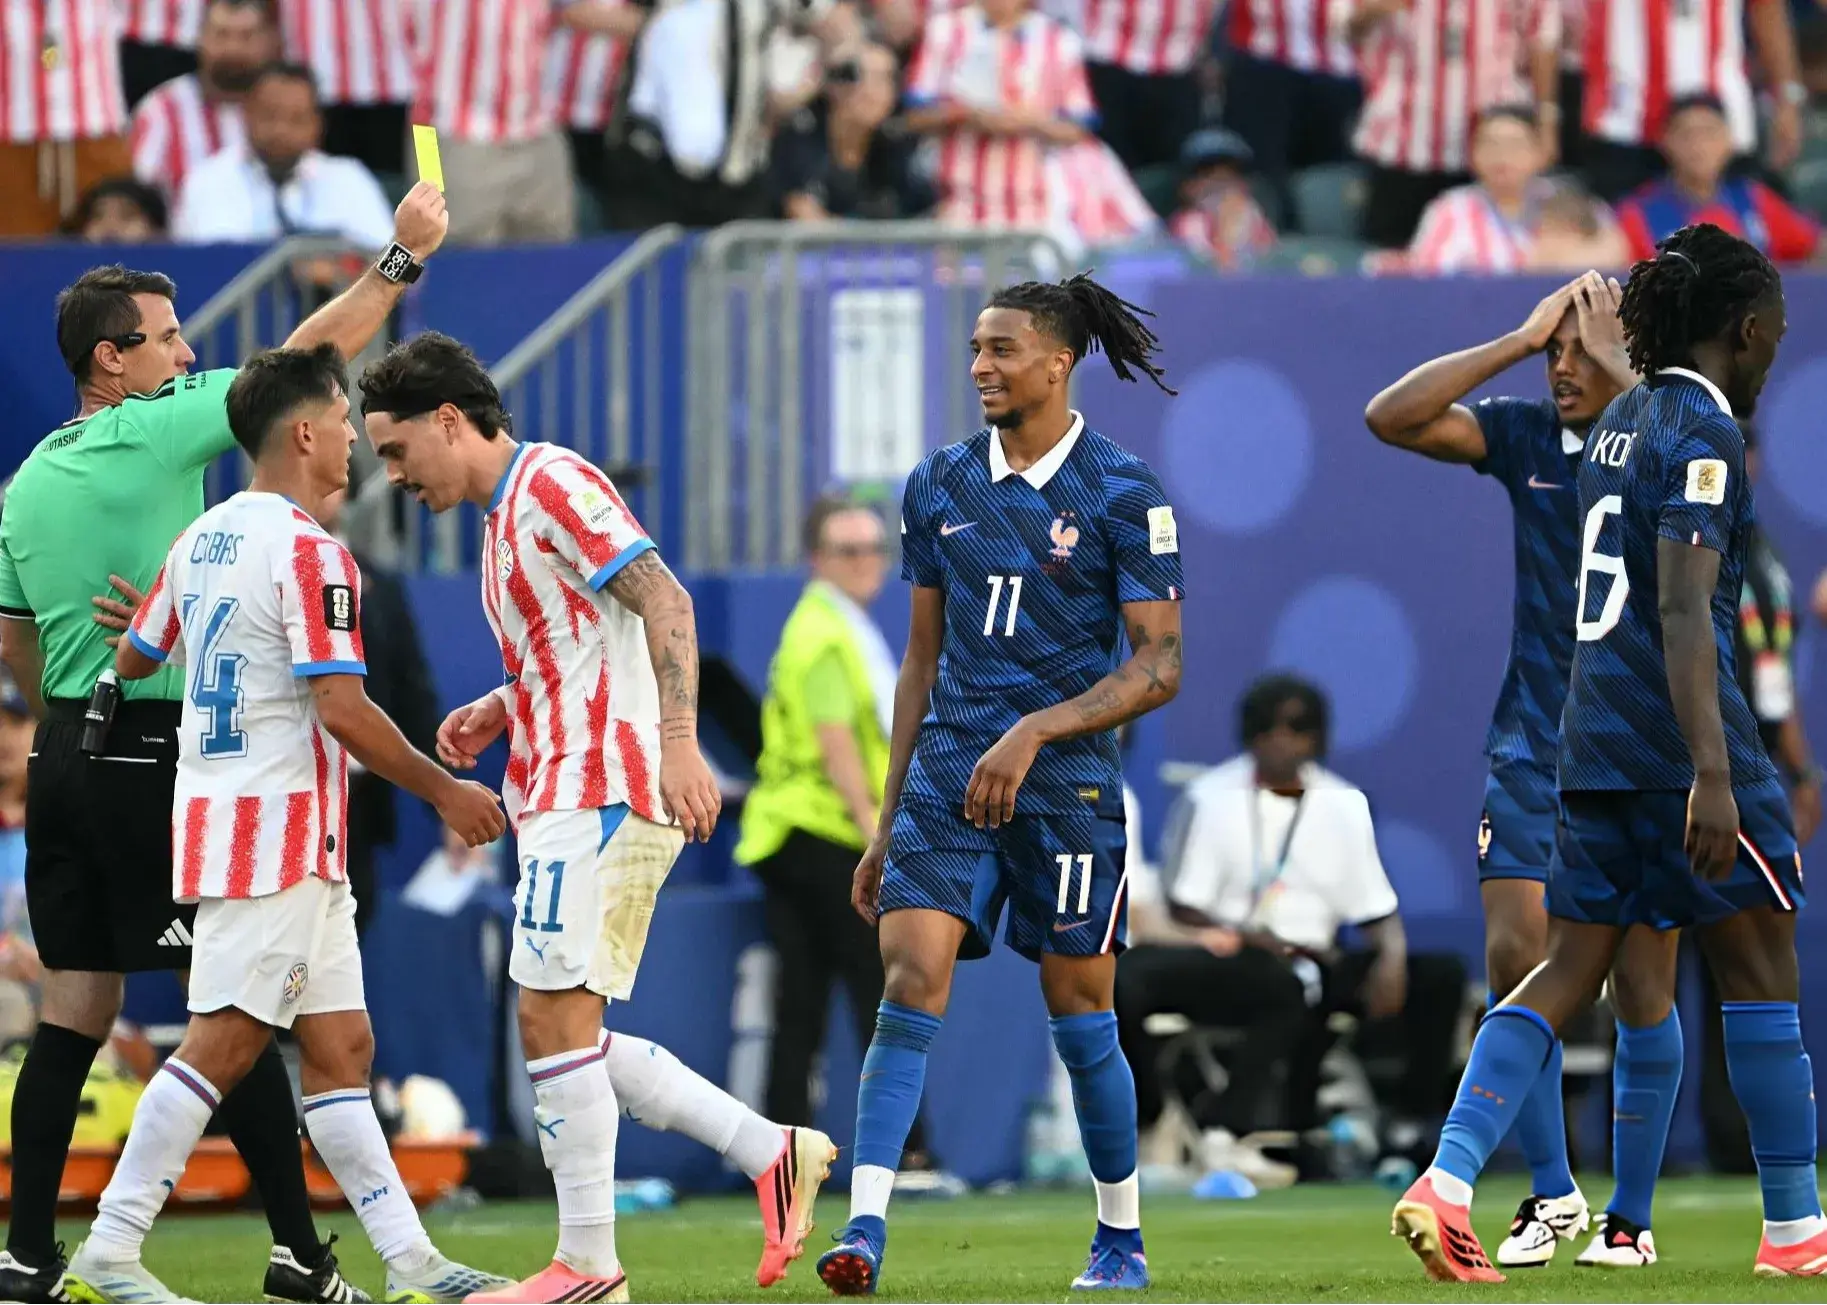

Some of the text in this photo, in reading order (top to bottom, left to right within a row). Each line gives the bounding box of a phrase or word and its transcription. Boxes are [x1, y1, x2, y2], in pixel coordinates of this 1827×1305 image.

[1575, 494, 1630, 642] 6
[983, 574, 1023, 637] 11
[519, 859, 566, 933] 11
[1055, 854, 1094, 914] 11
